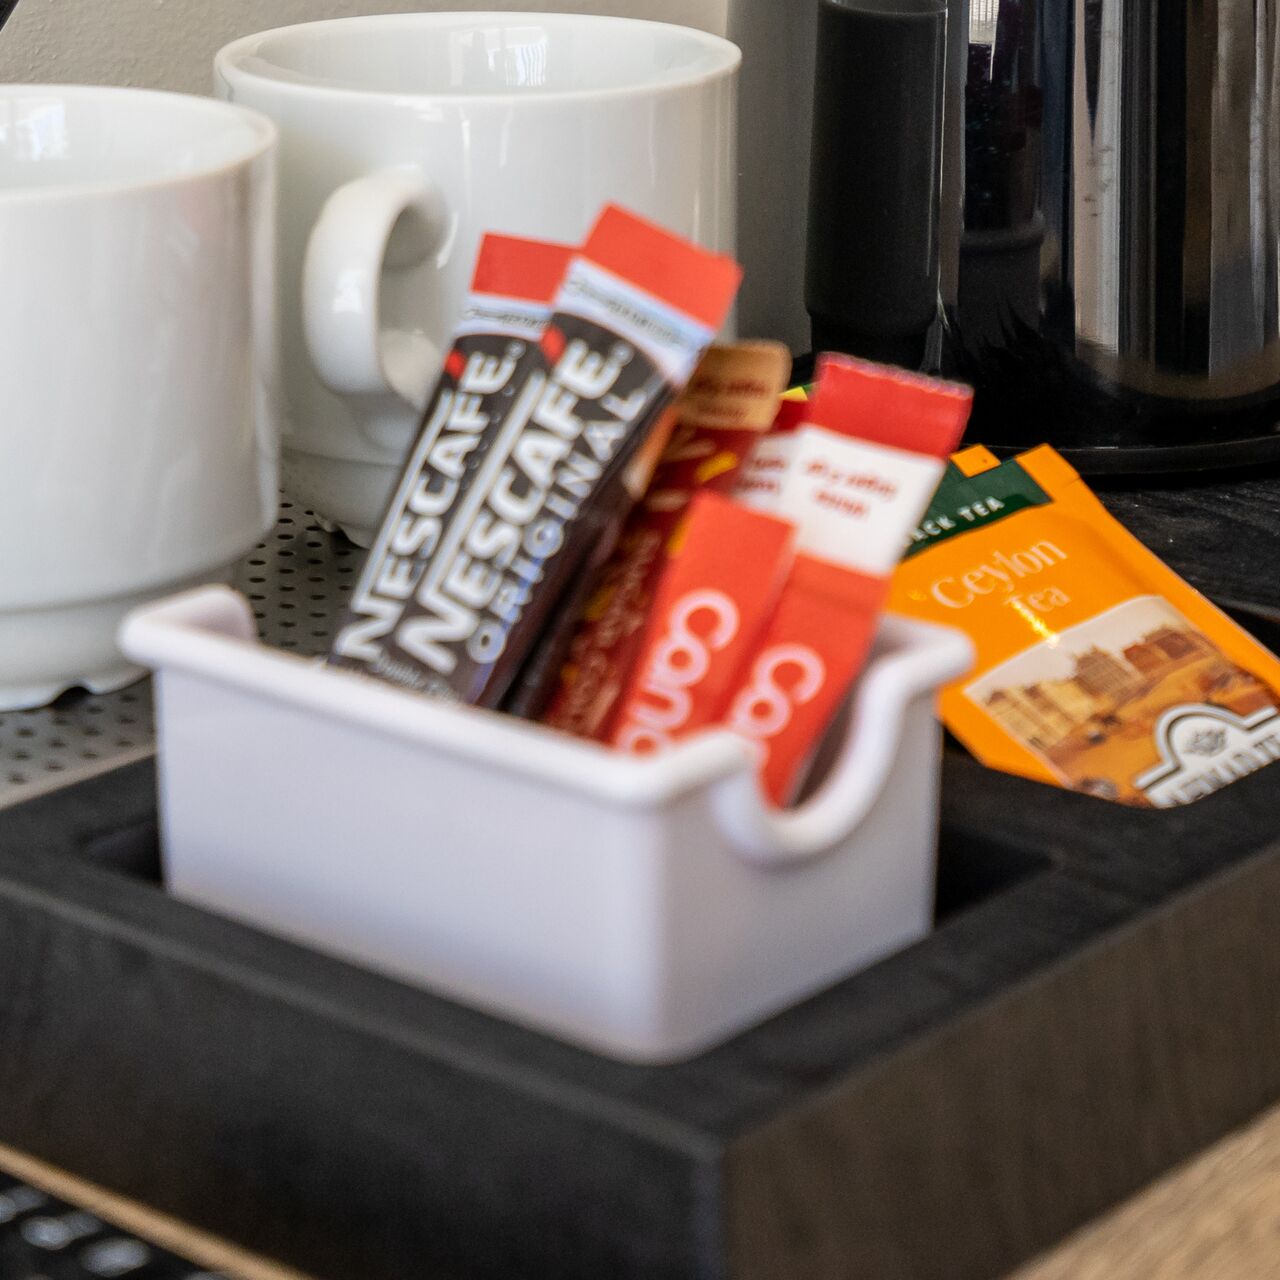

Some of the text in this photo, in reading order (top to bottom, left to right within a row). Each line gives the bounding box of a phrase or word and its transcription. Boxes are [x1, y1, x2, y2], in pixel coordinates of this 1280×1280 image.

[467, 387, 648, 665] ORIGINAL
[957, 496, 1005, 522] TEA
[931, 540, 1068, 609] Ceylon
[1003, 586, 1071, 623] Tea
